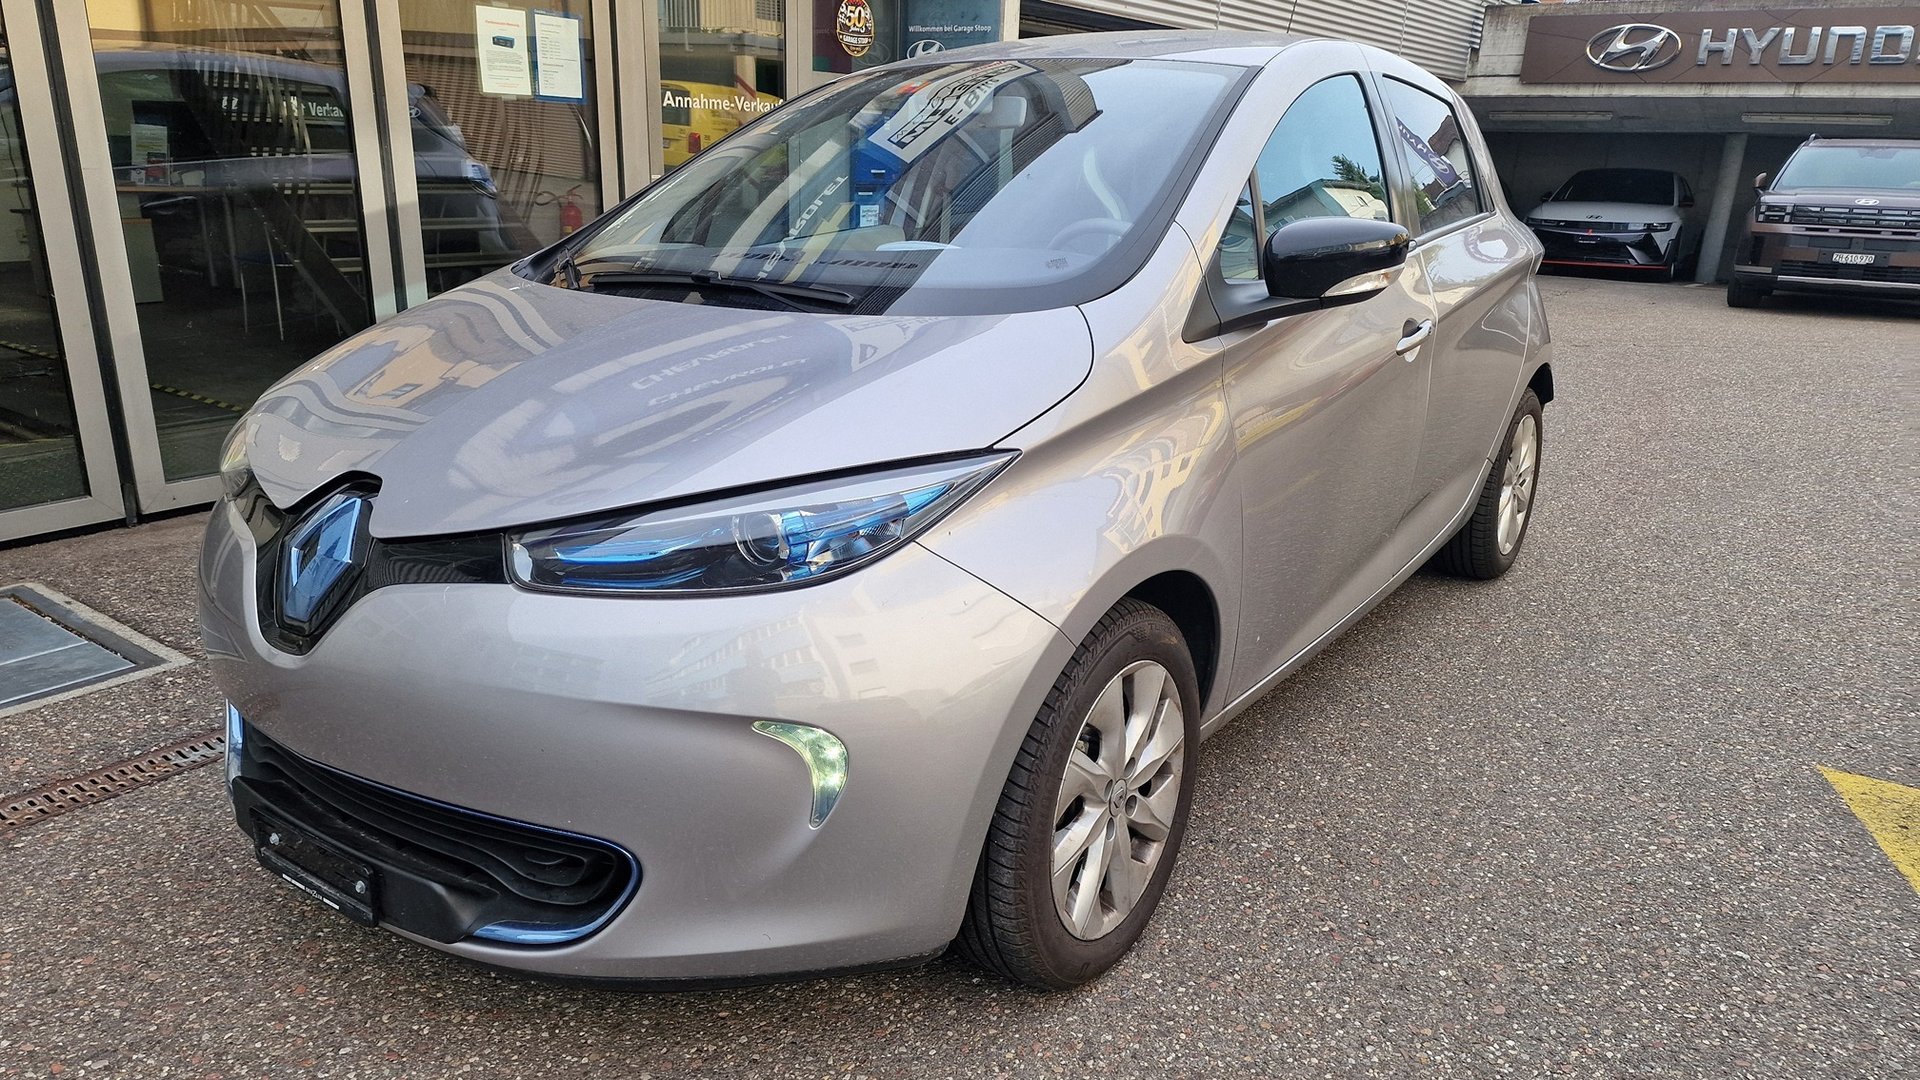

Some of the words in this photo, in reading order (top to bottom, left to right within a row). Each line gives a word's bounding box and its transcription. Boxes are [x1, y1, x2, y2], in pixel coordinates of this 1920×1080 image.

[953, 25, 974, 34] Garage
[974, 24, 992, 33] Stoop
[1696, 25, 1920, 65] HYUND
